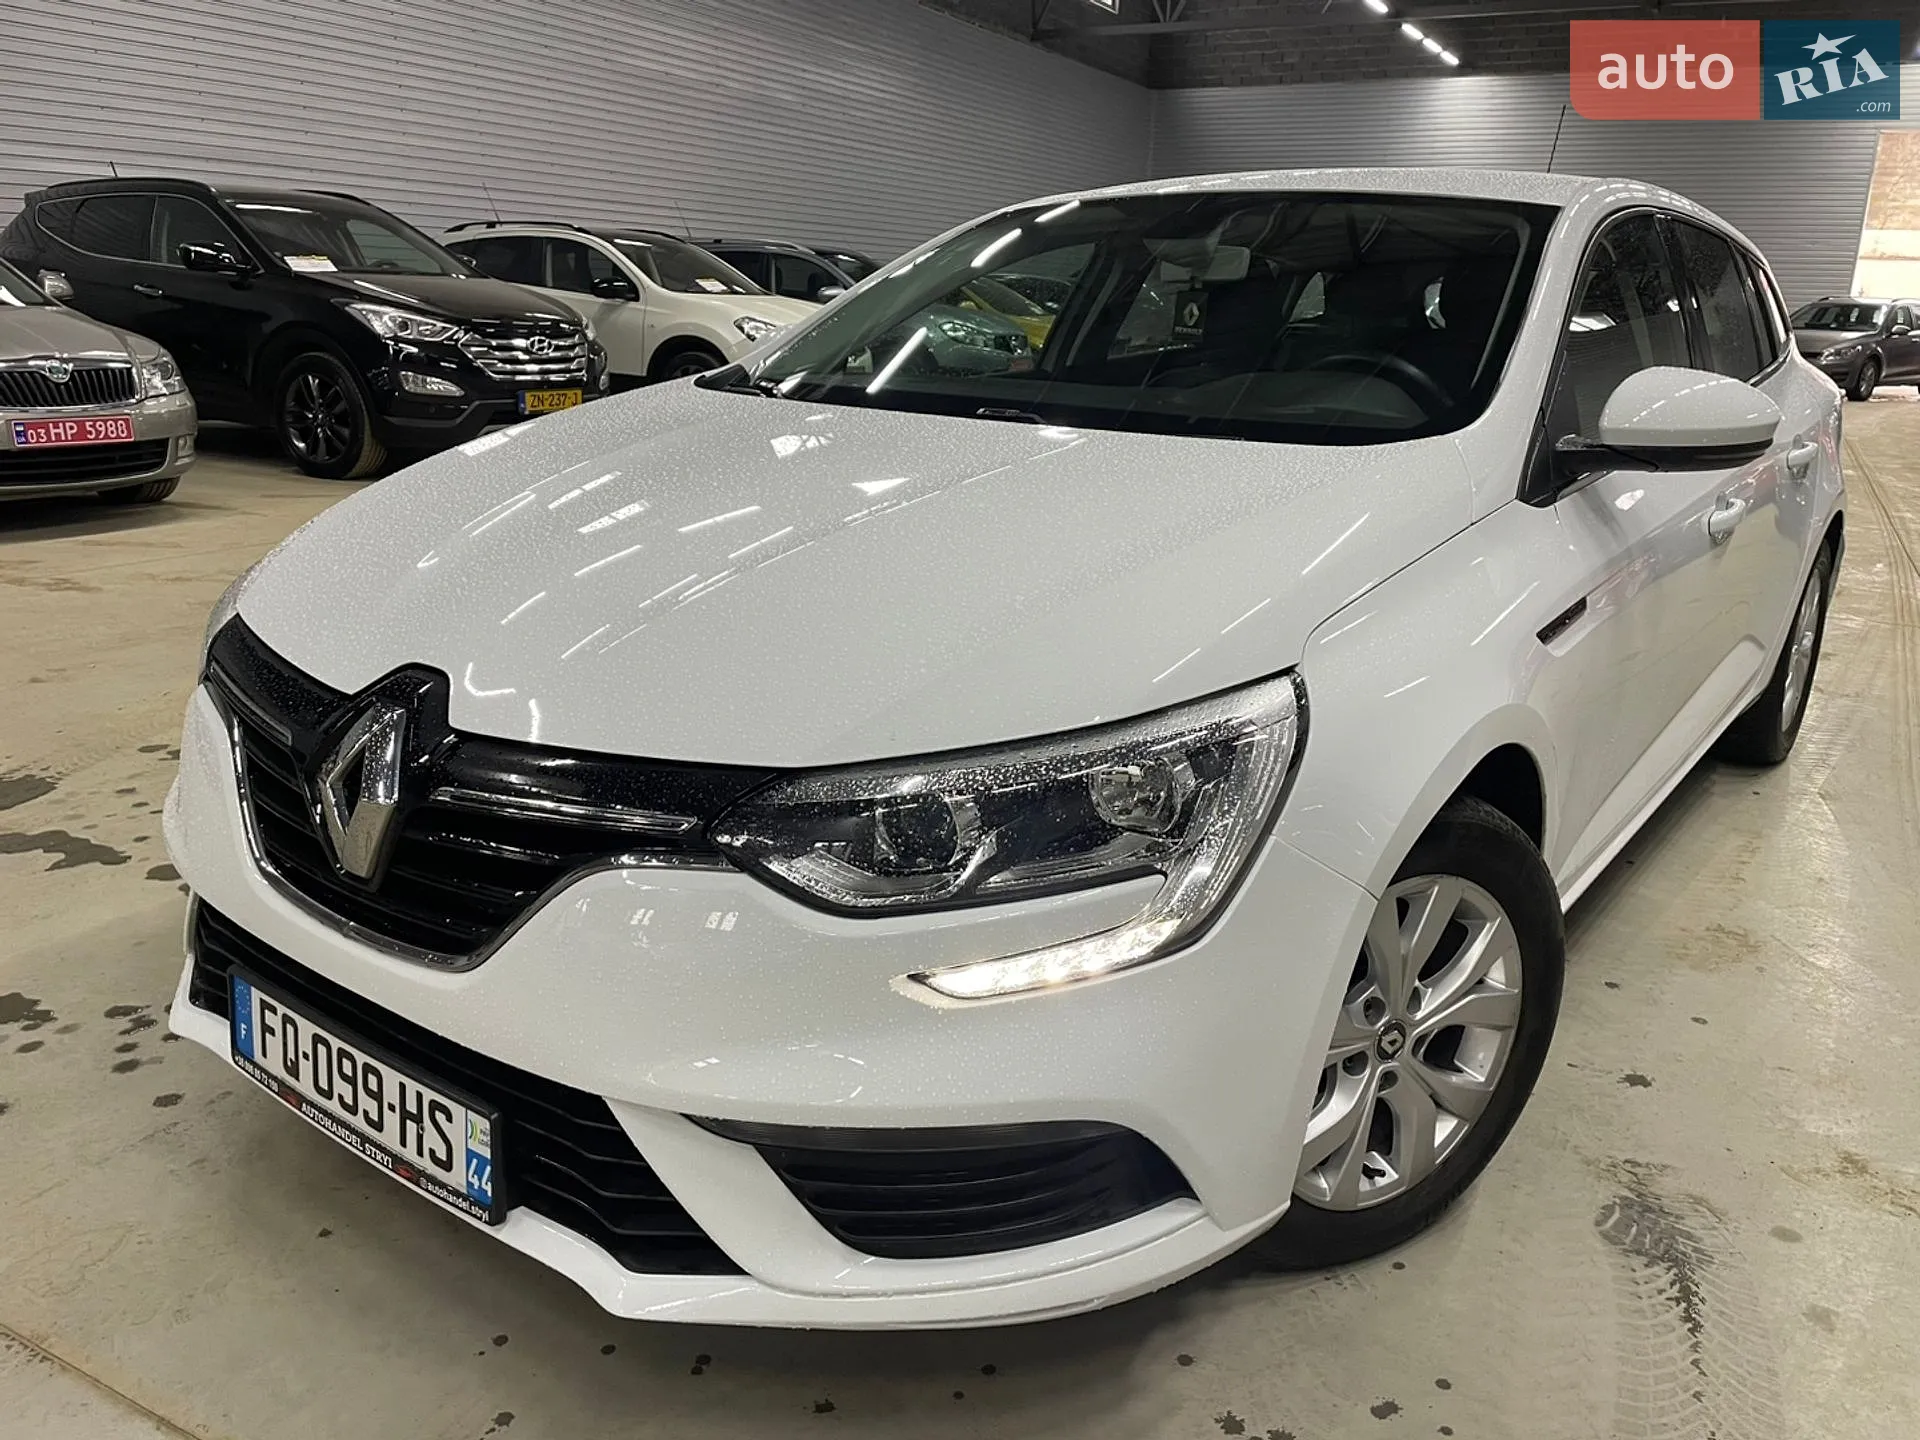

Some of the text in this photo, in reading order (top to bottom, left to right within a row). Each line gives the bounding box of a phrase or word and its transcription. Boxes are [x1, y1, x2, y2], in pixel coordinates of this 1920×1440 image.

[85, 420, 128, 439] 5988
[240, 1022, 248, 1040] F
[259, 997, 454, 1173] FQ-099-HS
[301, 1102, 393, 1169] AUTOHANDEL STRYI
[468, 1158, 492, 1197] 44
